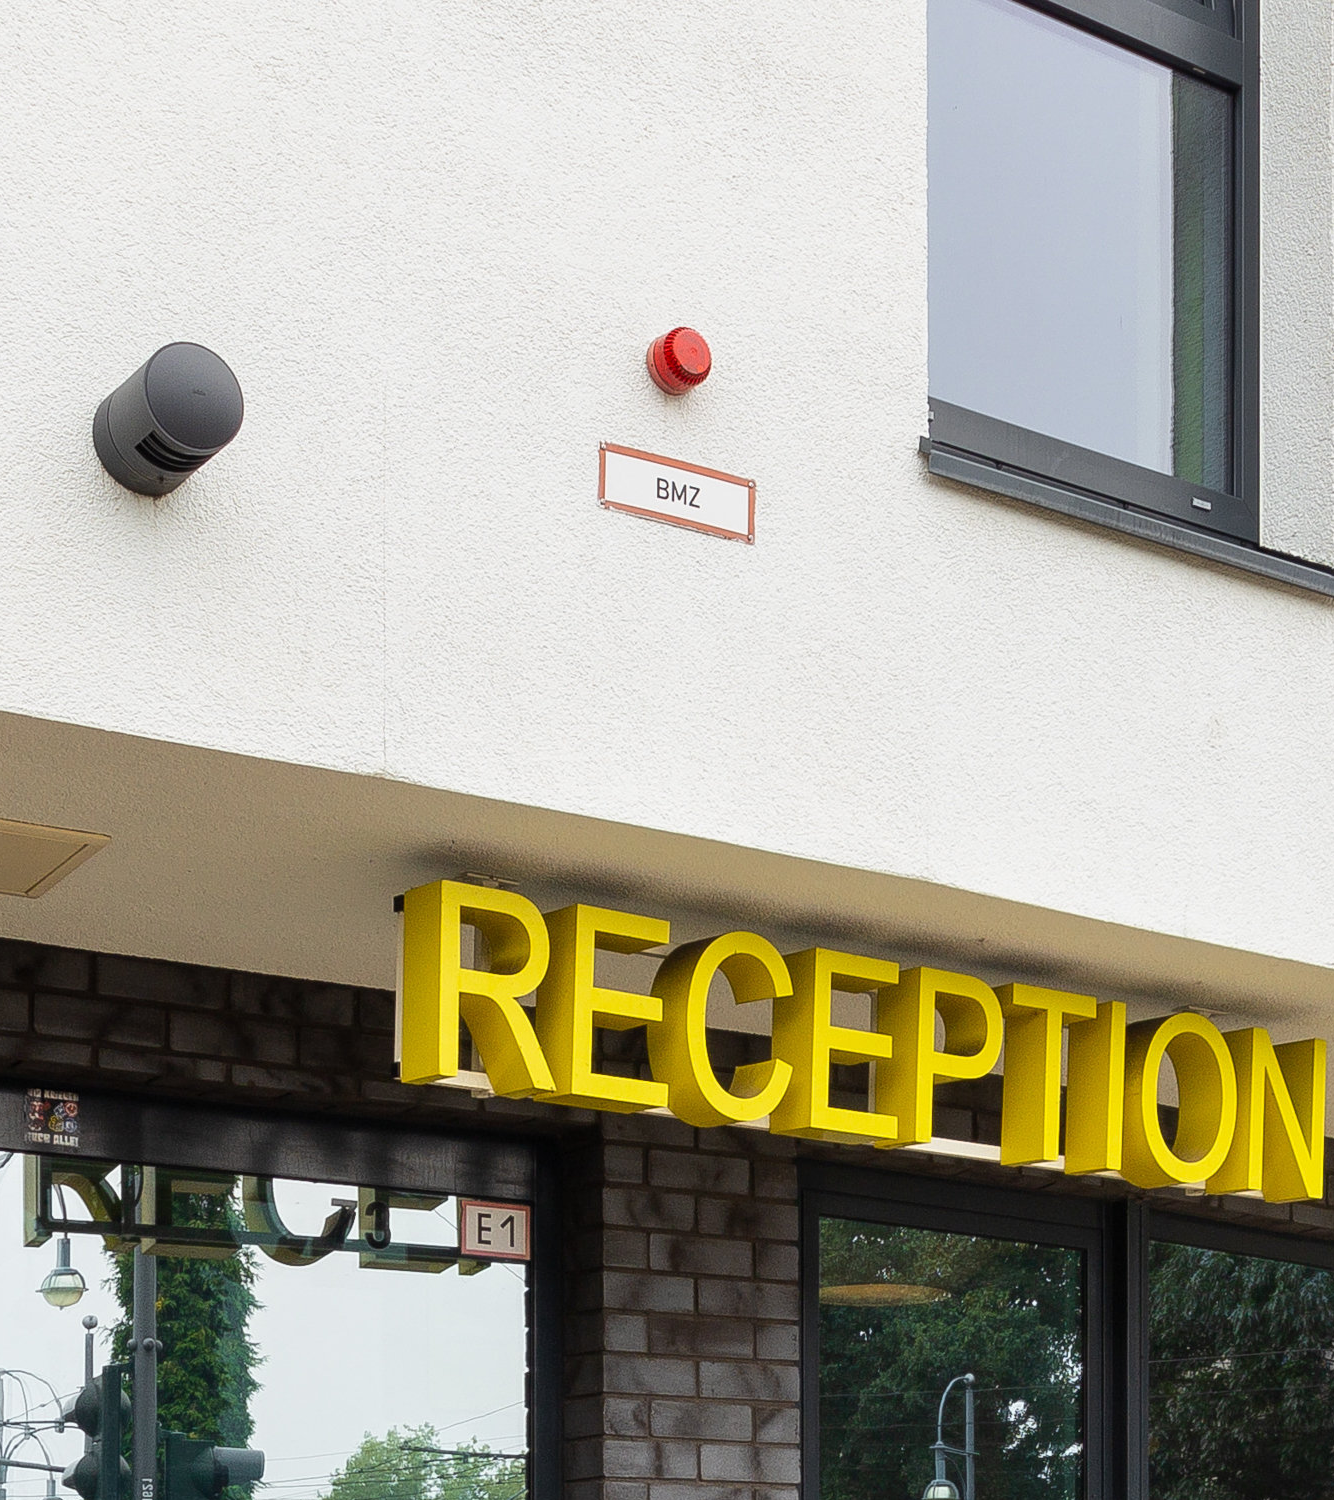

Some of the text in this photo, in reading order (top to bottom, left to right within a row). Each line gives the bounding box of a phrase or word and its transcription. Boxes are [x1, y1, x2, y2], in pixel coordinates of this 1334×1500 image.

[656, 477, 701, 509] BMZ
[400, 878, 1327, 1203] RECEPTION
[477, 1212, 516, 1248] E1
